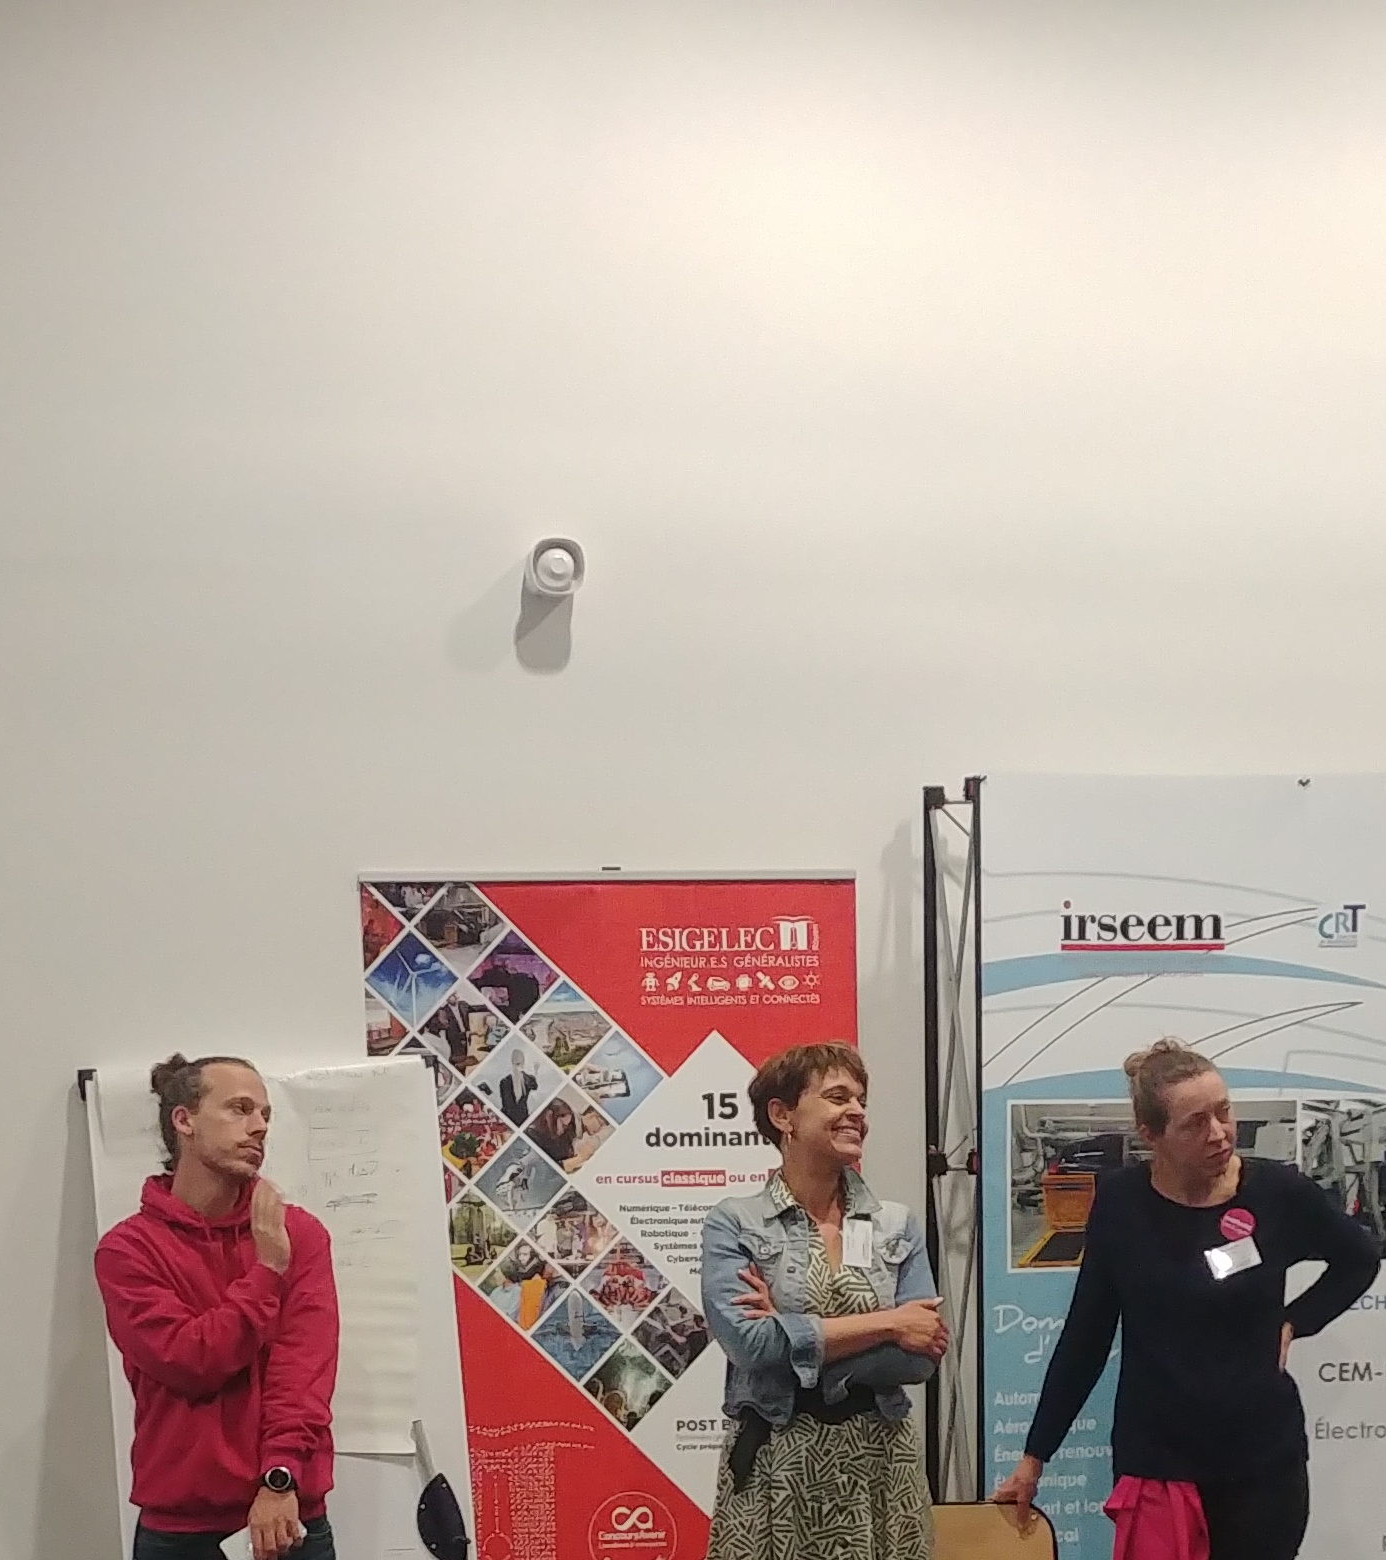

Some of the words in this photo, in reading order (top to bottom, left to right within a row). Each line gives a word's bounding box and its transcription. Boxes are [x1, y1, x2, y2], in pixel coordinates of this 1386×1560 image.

[1061, 899, 1226, 943] irseem
[1317, 903, 1366, 940] CRT
[639, 927, 775, 952] ESIGELEC
[733, 953, 820, 968] GÉNÉRALISTES
[687, 994, 747, 1006] INTELLIGENTS
[749, 995, 761, 1005] ET
[702, 1092, 739, 1120] 15
[595, 1175, 612, 1185] en
[616, 1174, 659, 1184] cursus
[663, 1171, 725, 1186] classique
[728, 1173, 745, 1183] ou
[749, 1173, 766, 1183] en
[619, 1204, 670, 1214] Numérique
[630, 1215, 689, 1226] Électronique
[690, 1216, 705, 1225] aut
[640, 1229, 689, 1239] Robotique
[653, 1242, 698, 1252] Systèmes
[676, 1419, 717, 1431] POST
